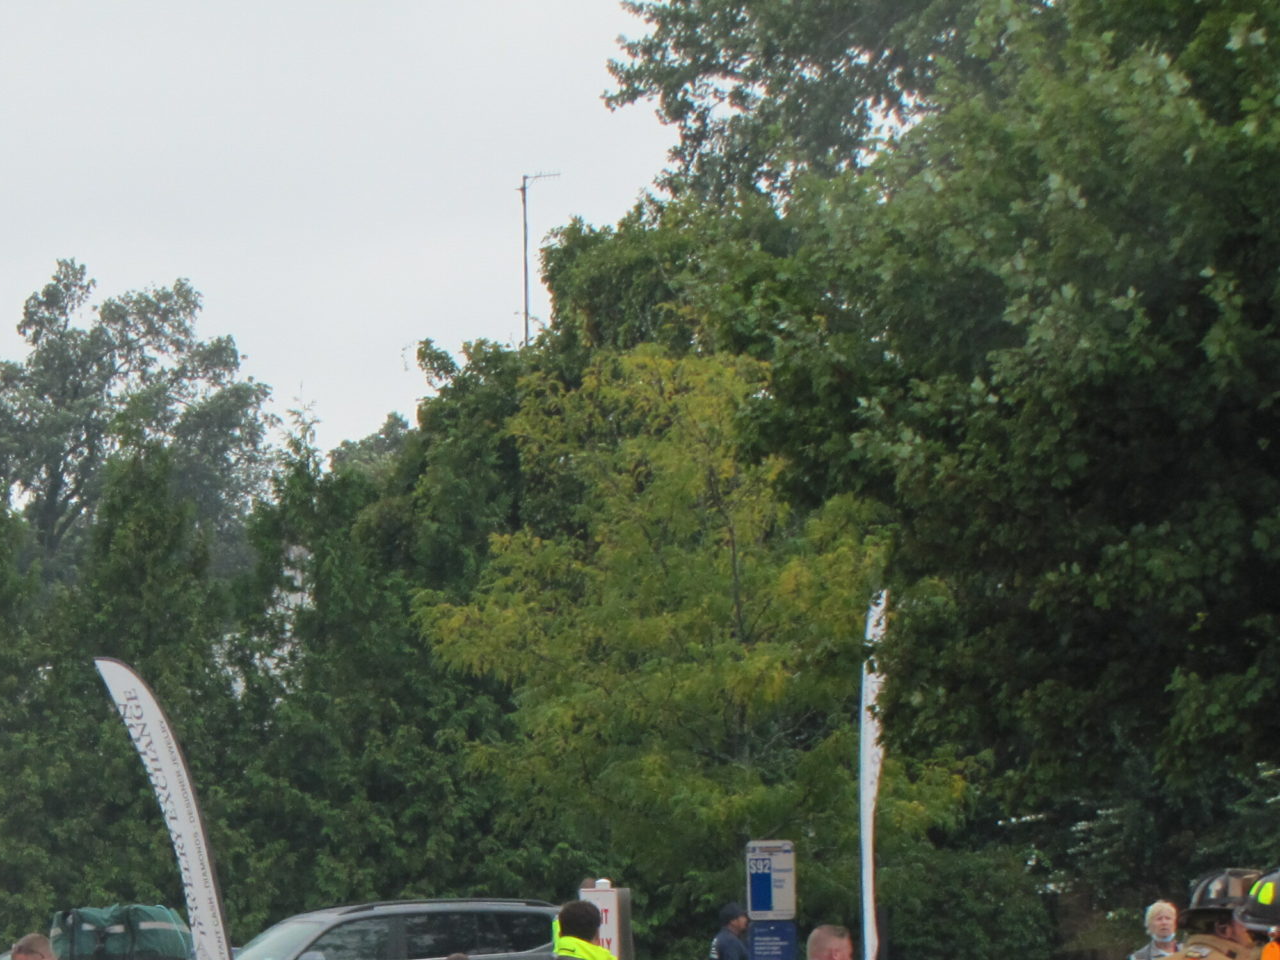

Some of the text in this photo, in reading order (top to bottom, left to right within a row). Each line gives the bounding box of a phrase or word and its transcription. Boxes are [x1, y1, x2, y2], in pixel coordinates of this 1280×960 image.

[175, 770, 196, 824] DESIGNER
[194, 832, 210, 889] DIAMONDS
[749, 859, 772, 874] S92
[207, 896, 221, 927] CASH
